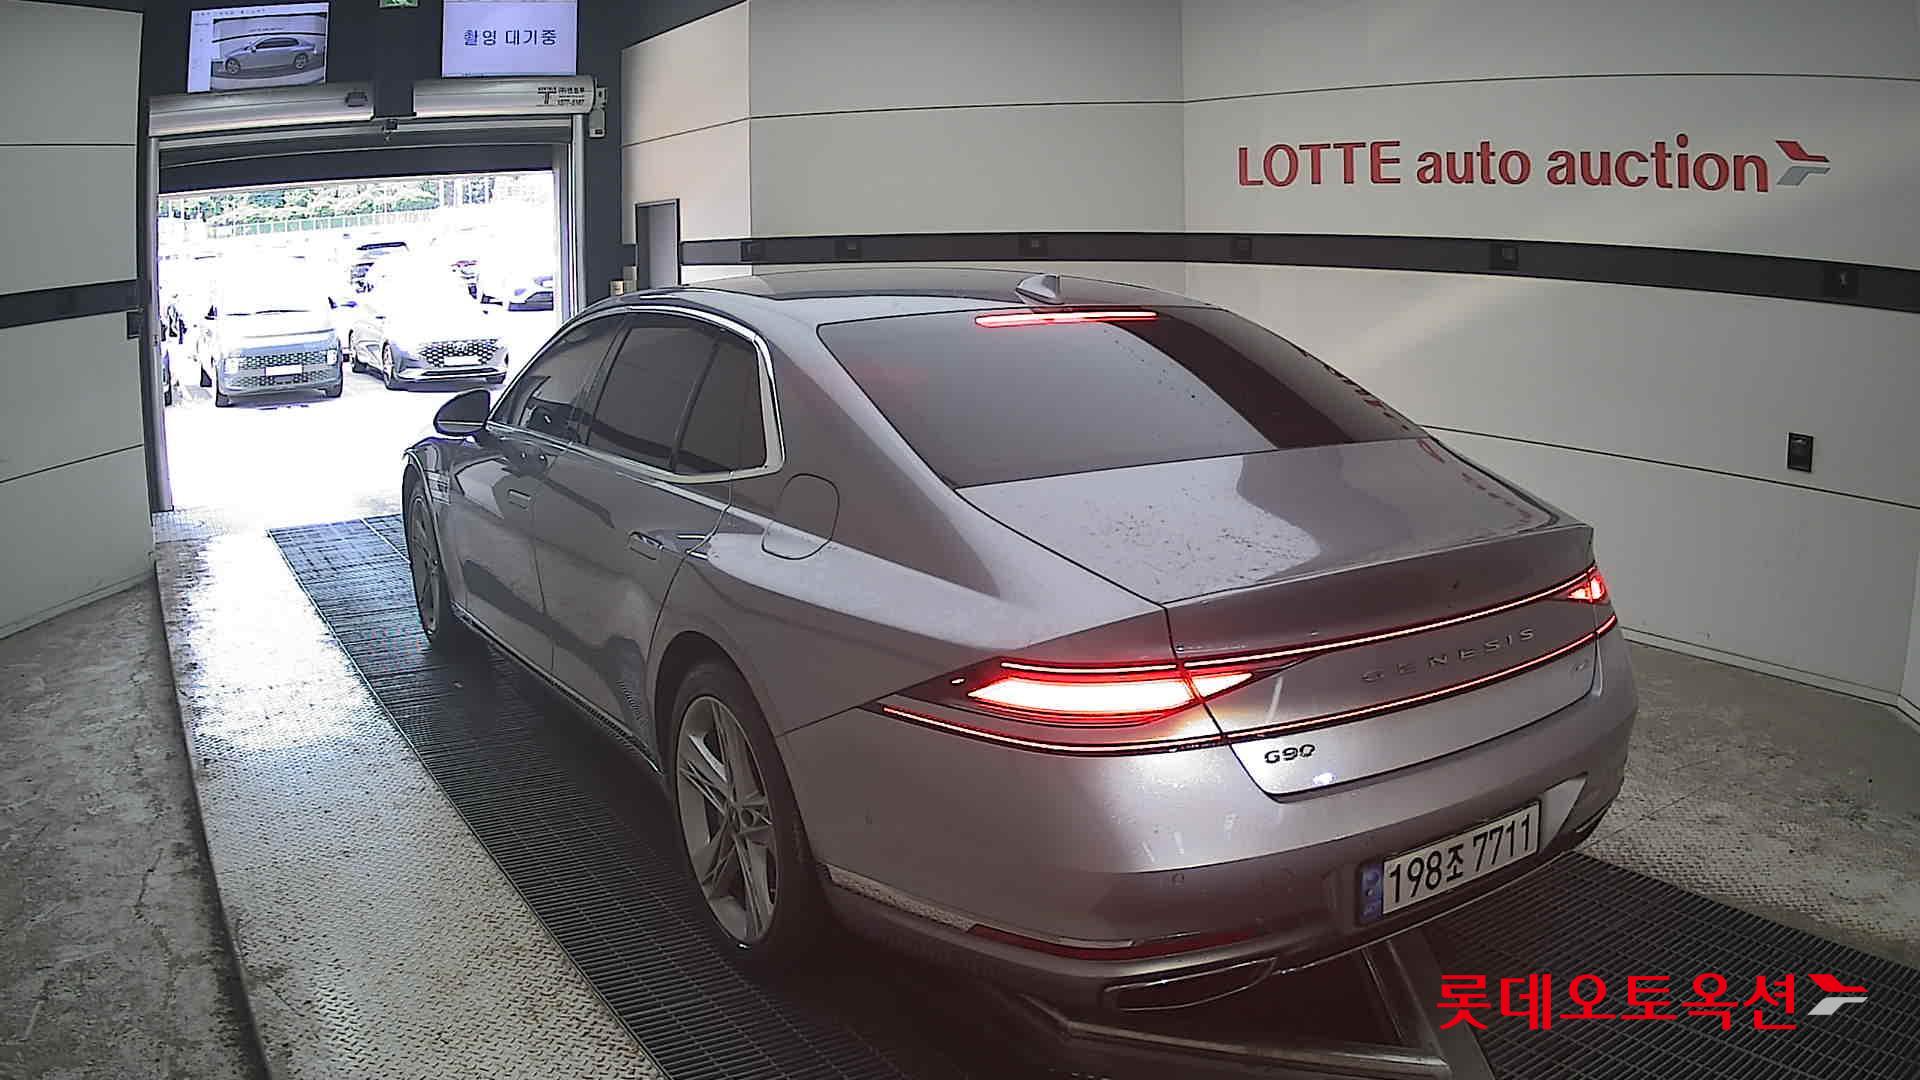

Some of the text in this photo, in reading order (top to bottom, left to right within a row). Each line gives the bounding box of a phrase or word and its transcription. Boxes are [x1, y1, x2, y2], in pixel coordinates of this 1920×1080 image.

[463, 29, 558, 46] 촬영 대기중
[1238, 133, 1769, 193] LOTTE auto auction
[1361, 628, 1535, 683] GENESIS
[1264, 744, 1316, 764] G90
[1389, 813, 1531, 904] 198조 7711
